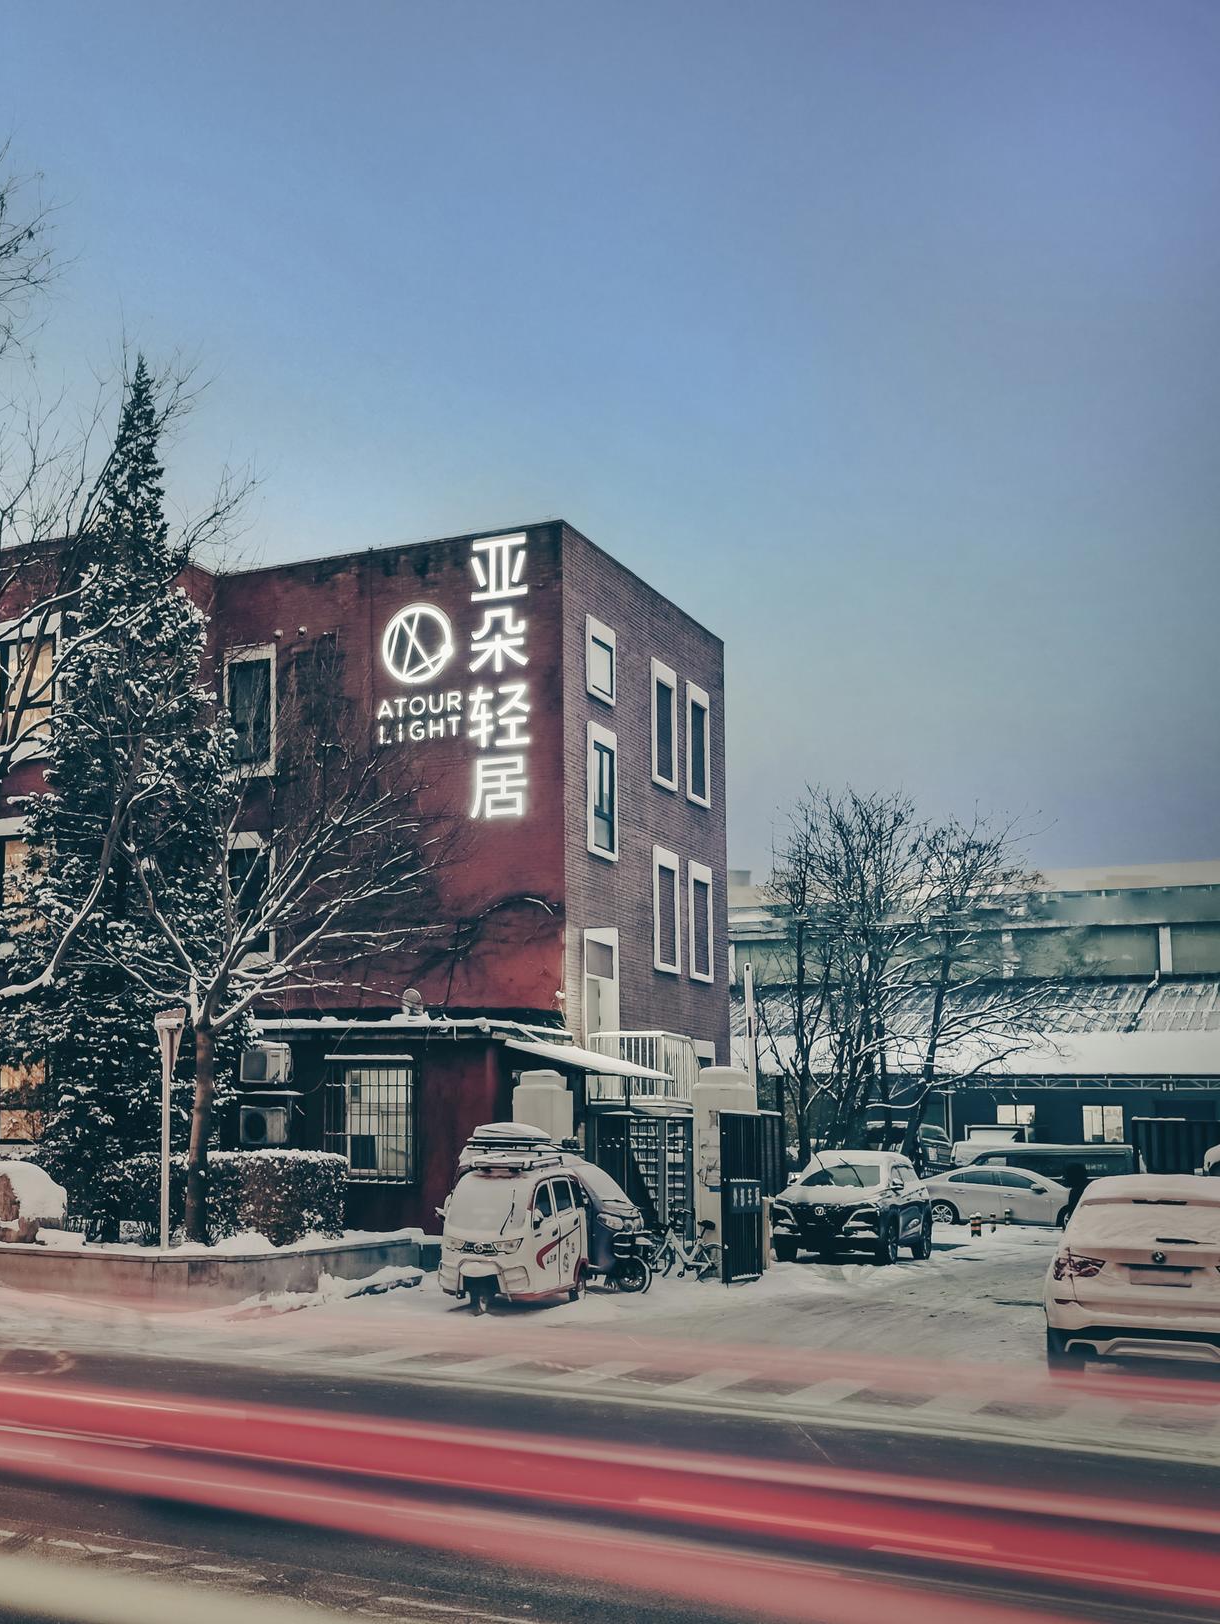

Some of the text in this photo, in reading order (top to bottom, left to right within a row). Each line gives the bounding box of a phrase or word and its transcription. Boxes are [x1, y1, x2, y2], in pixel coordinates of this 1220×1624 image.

[469, 532, 530, 818] 亚朵轻居
[378, 691, 462, 720] ATOUR
[379, 716, 461, 744] LIGHT
